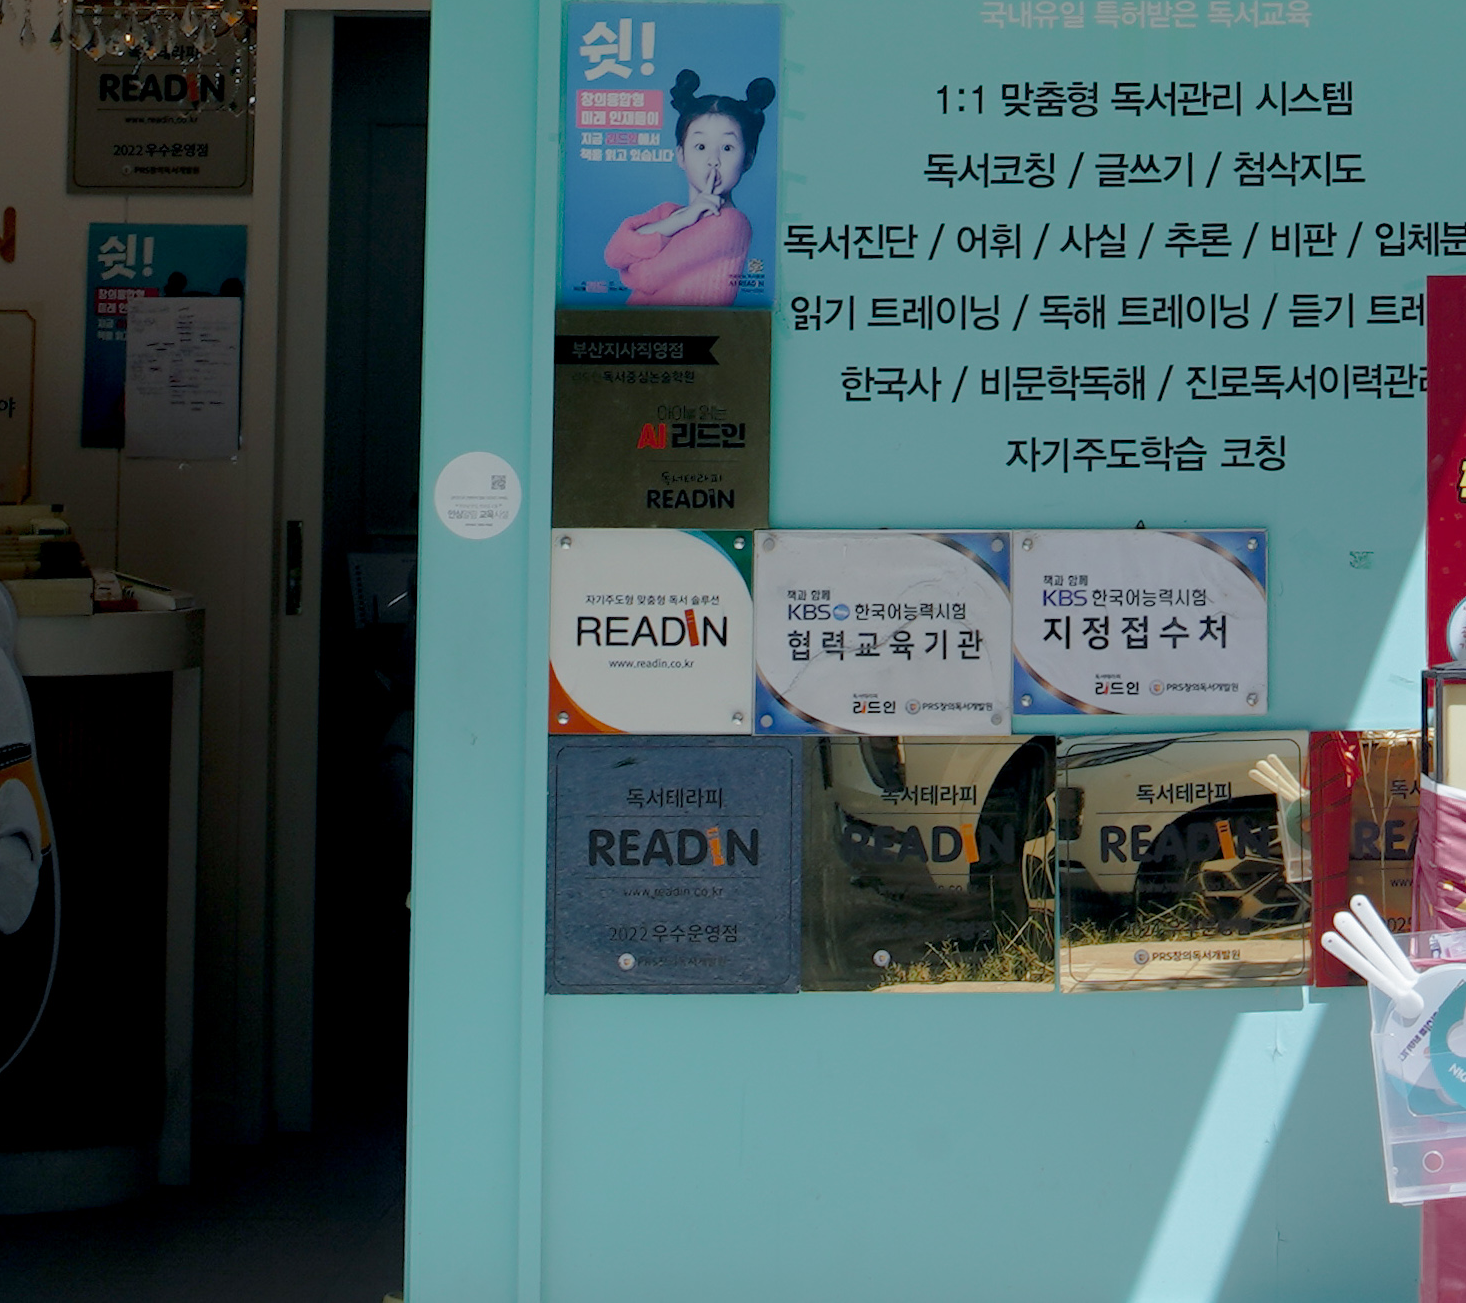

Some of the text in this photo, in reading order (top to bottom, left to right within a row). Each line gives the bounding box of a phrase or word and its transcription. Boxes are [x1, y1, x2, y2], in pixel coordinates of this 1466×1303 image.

[980, 0, 1312, 29] 국내유일 특허받은 독서교육
[580, 18, 655, 81] 쉿!
[936, 81, 1354, 117] 1:1 맞춤형 독서관리 시스템
[581, 111, 658, 125] 미래 인재들이
[581, 132, 603, 145] 지금
[114, 143, 208, 157] 2022 우수운영점
[581, 149, 674, 162] 책을 읽고 있습니다
[923, 151, 1366, 188] 독서코칭 글쓰기 첨삭지도
[783, 223, 918, 260] 독서진단
[956, 223, 1022, 260] 어휘
[1059, 223, 1127, 259] 사실
[1165, 222, 1232, 258] 추론
[1271, 222, 1337, 258] 비판
[98, 234, 154, 280] 쉿!
[790, 292, 1354, 331] 읽기 트레이닝 독해 트레이닝 듣기
[572, 342, 683, 359] 부산지사직영점
[840, 365, 942, 403] 한국사
[981, 364, 1147, 402] 비문학독해
[637, 423, 746, 449] AI 리드인
[1006, 434, 1287, 474] 자기주도학습 코칭
[1043, 575, 1088, 586] 책과 함께
[585, 595, 634, 605] 자기주도형
[669, 595, 688, 605] 독서
[691, 595, 720, 605] 솔루션
[787, 590, 831, 601] 책과 함께
[1043, 589, 1206, 607] KBS 한국어능력시험
[788, 603, 966, 621] KBS 한국어능력시험
[1043, 615, 1226, 650] 지정접수처
[787, 629, 982, 661] 협력교육기관
[609, 659, 694, 669] www.readin.co.kr
[1095, 681, 1139, 695] 리드인
[853, 700, 896, 714] 리드인
[627, 788, 722, 808] 독서테라피
[882, 785, 976, 805] 독서테라피
[1136, 782, 1232, 804] 독서테라피
[609, 925, 737, 943] 2022 우수운영점
